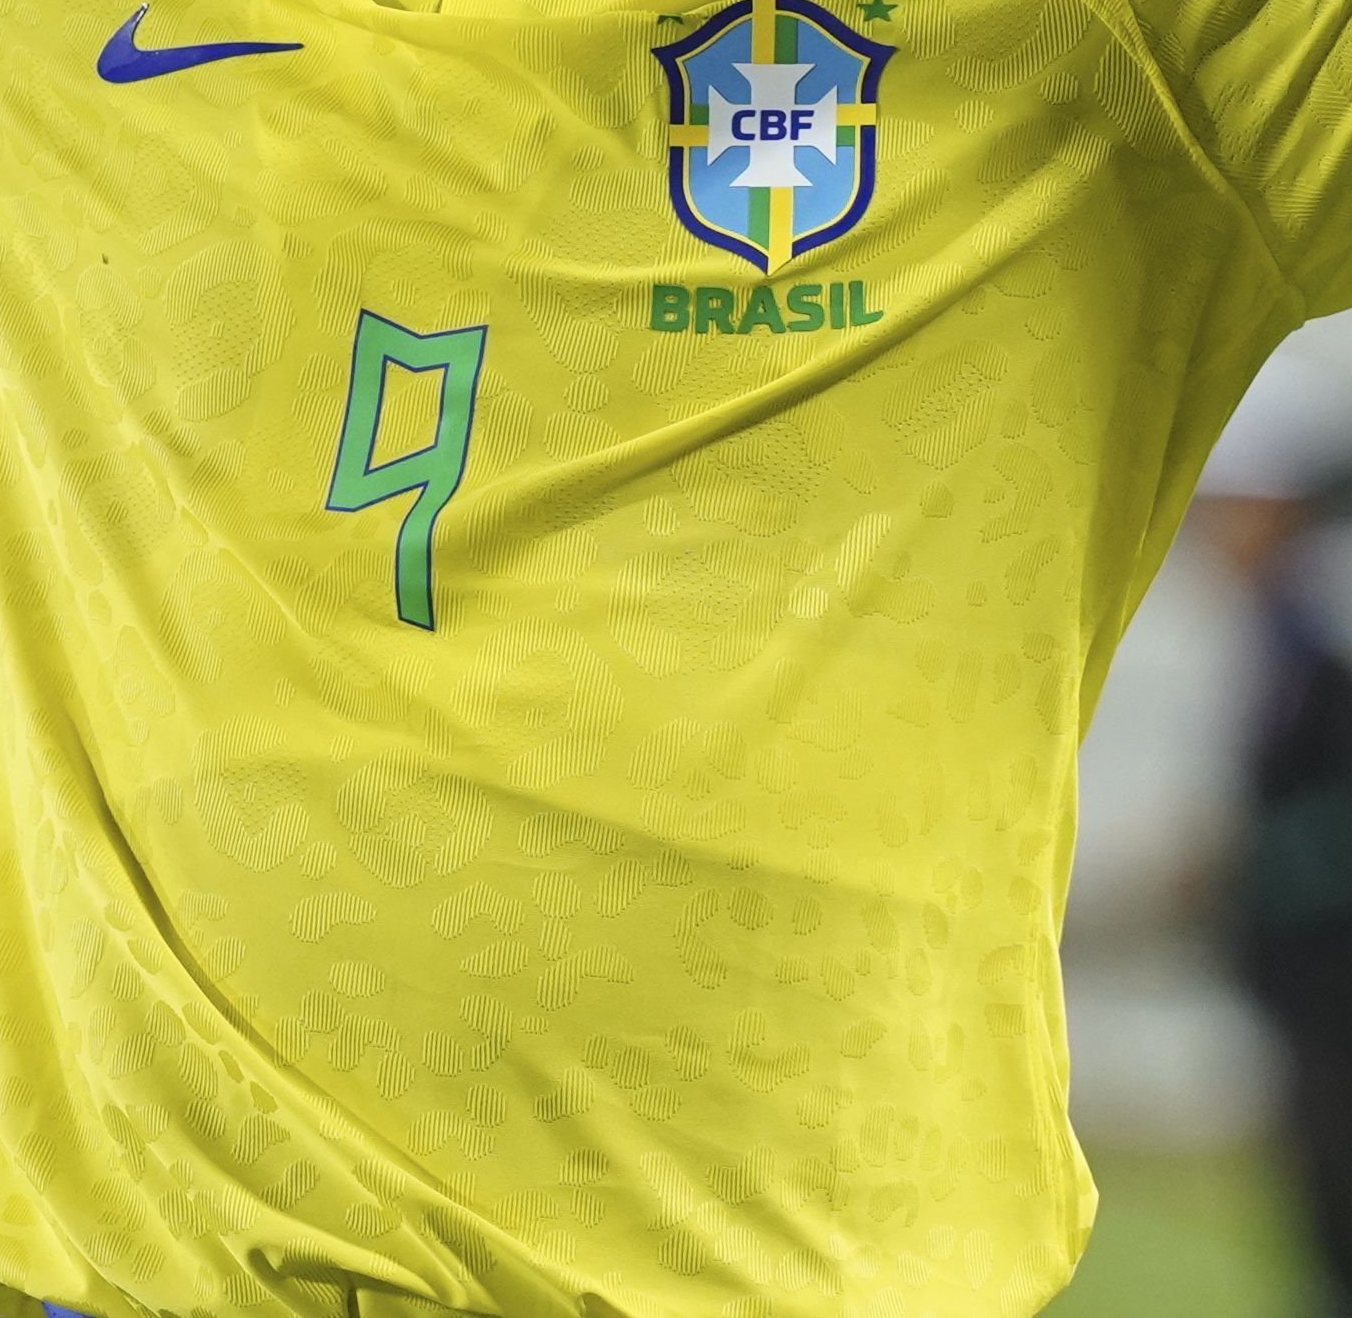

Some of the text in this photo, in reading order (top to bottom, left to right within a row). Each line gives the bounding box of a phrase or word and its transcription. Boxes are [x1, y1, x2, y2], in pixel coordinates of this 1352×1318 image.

[730, 108, 815, 141] CBF
[651, 280, 884, 334] BRASIL
[324, 308, 489, 632] 9
